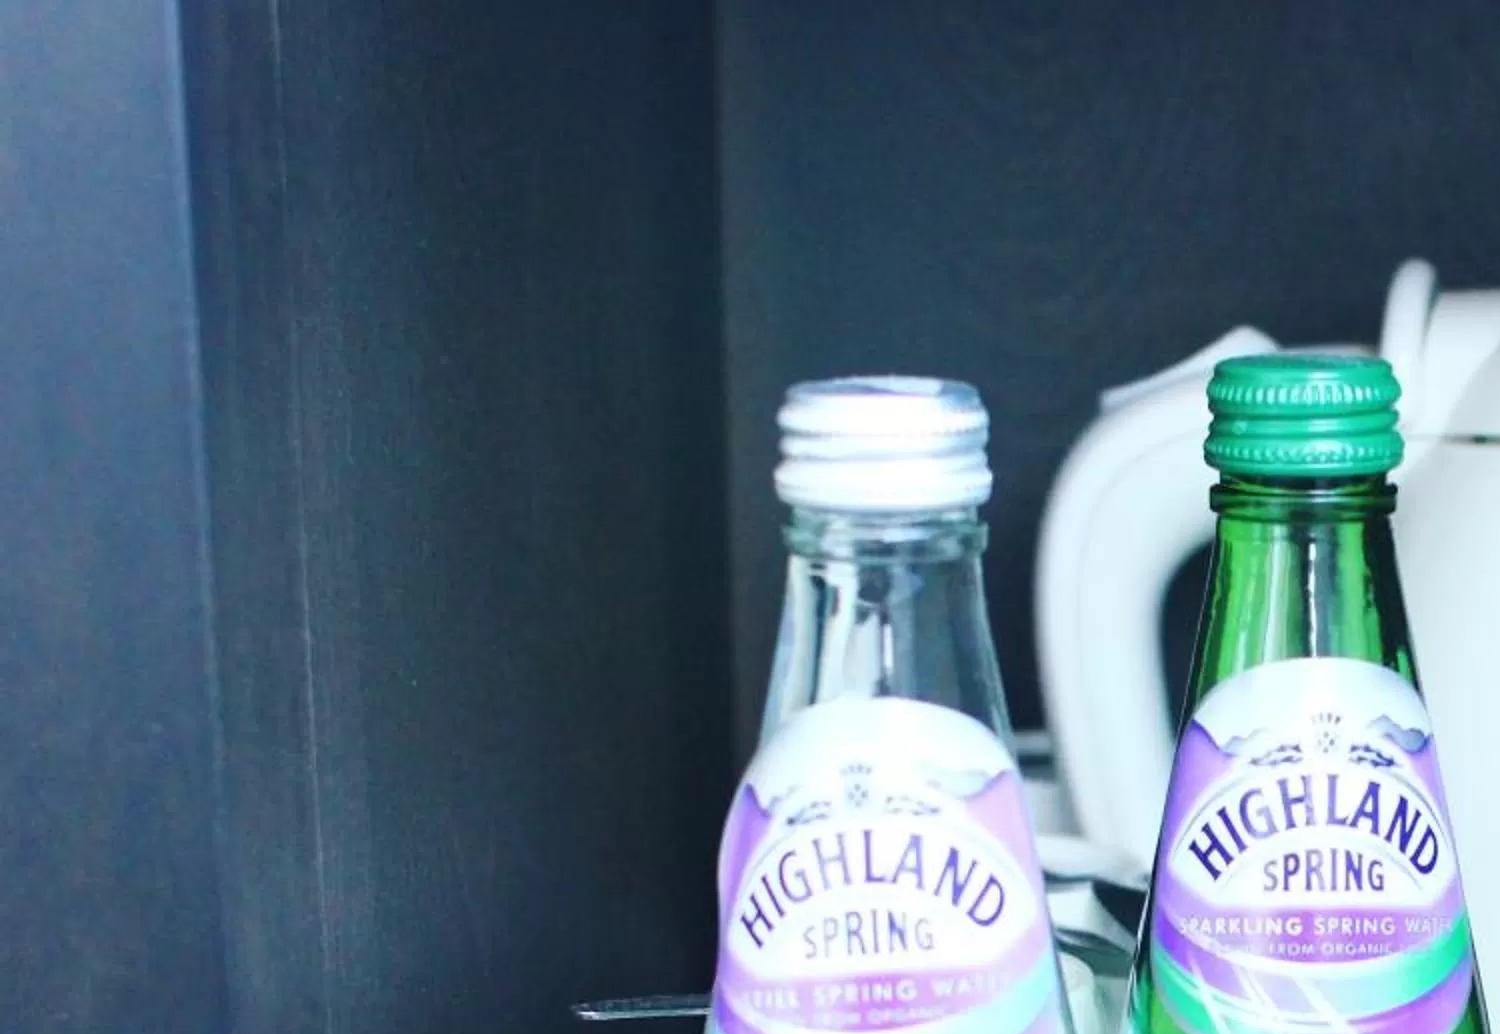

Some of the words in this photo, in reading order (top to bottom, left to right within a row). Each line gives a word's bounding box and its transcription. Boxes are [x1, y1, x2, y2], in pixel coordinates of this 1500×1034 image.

[1188, 773, 1440, 882] HIGHLAND
[740, 829, 1006, 949] HIGHLAND
[1263, 847, 1385, 893] SPRING
[803, 908, 936, 959] SPRING
[1178, 915, 1303, 936] SPARKLING
[1313, 915, 1396, 936] SPRING
[812, 979, 919, 1006] SPRING
